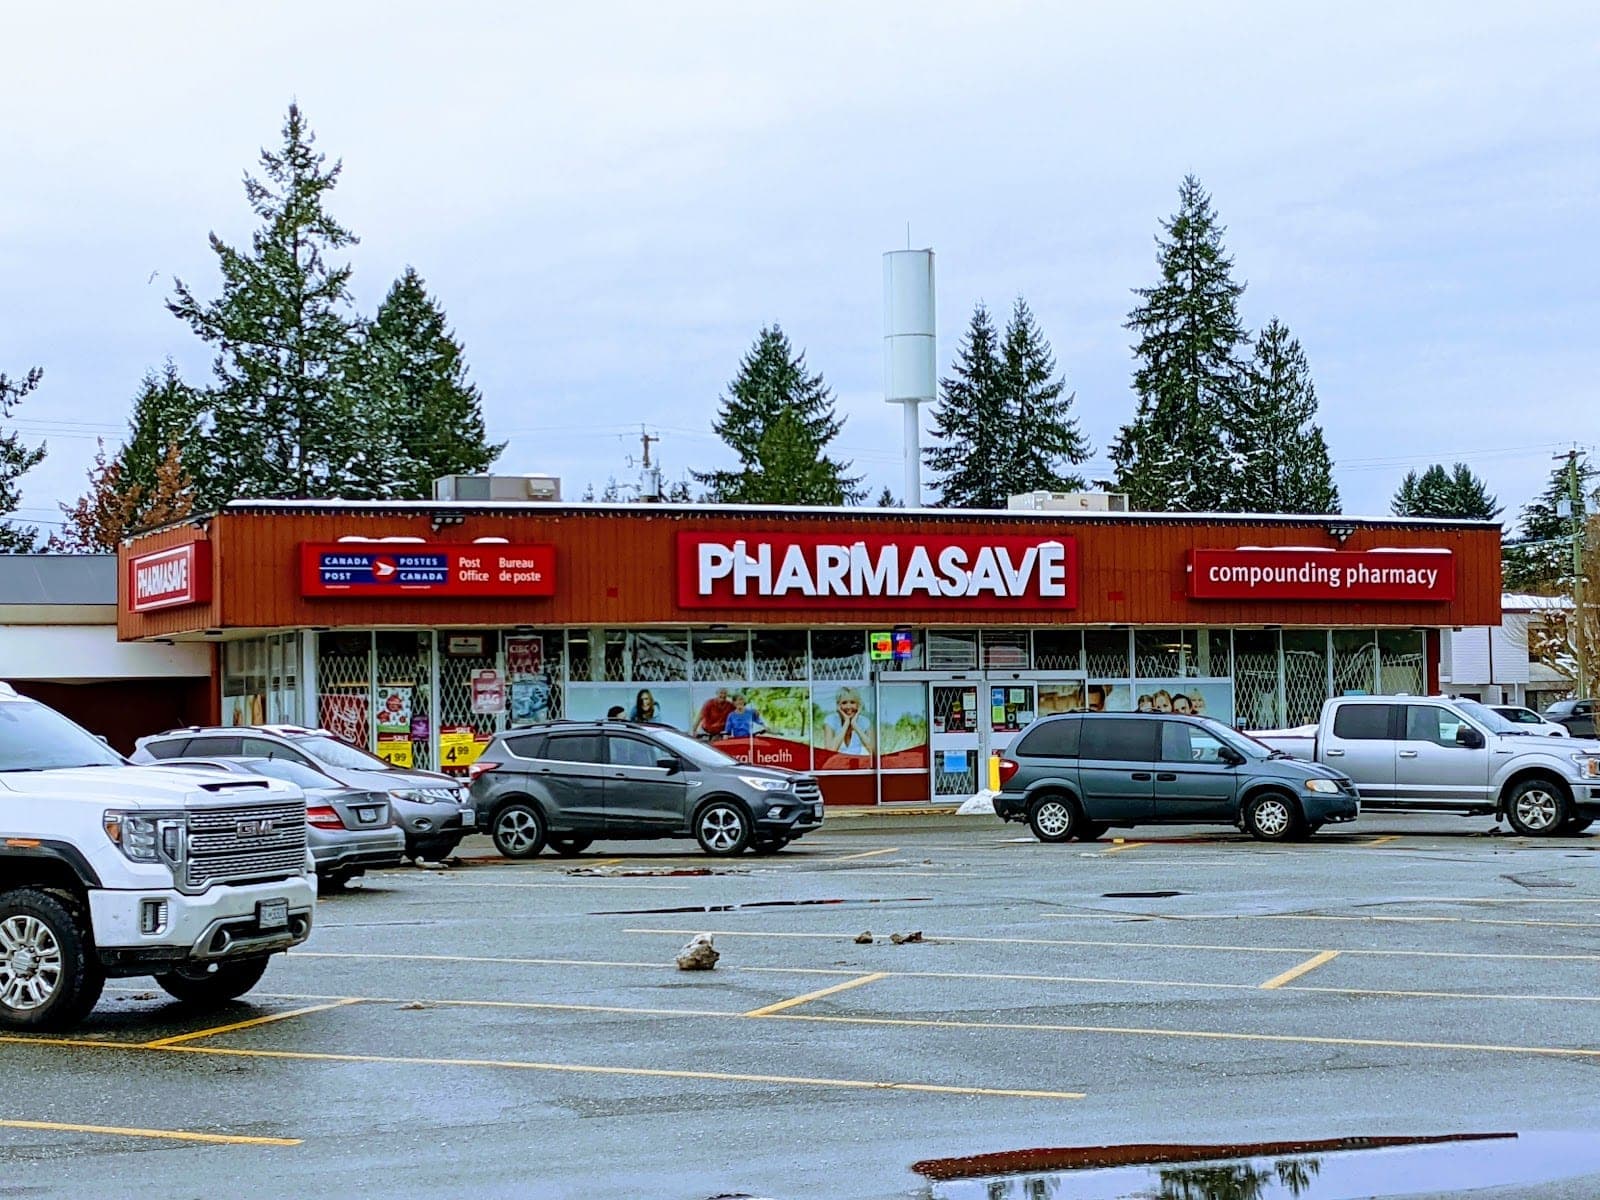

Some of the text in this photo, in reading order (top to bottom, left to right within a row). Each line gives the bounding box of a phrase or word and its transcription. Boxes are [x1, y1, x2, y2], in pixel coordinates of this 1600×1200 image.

[324, 557, 369, 566] CANADA
[400, 558, 438, 566] POSTES
[458, 557, 481, 569] Post
[499, 557, 534, 569] Bureau
[698, 541, 1066, 597] PHARMASAVE
[137, 558, 188, 599] PHARMASAVE
[324, 572, 352, 581] POST
[400, 573, 444, 581] CANADA
[458, 570, 490, 582] Office
[499, 570, 542, 584] de poste
[1209, 562, 1438, 589] compounding pharmacy
[757, 749, 793, 763] health
[237, 819, 283, 837] GMC
